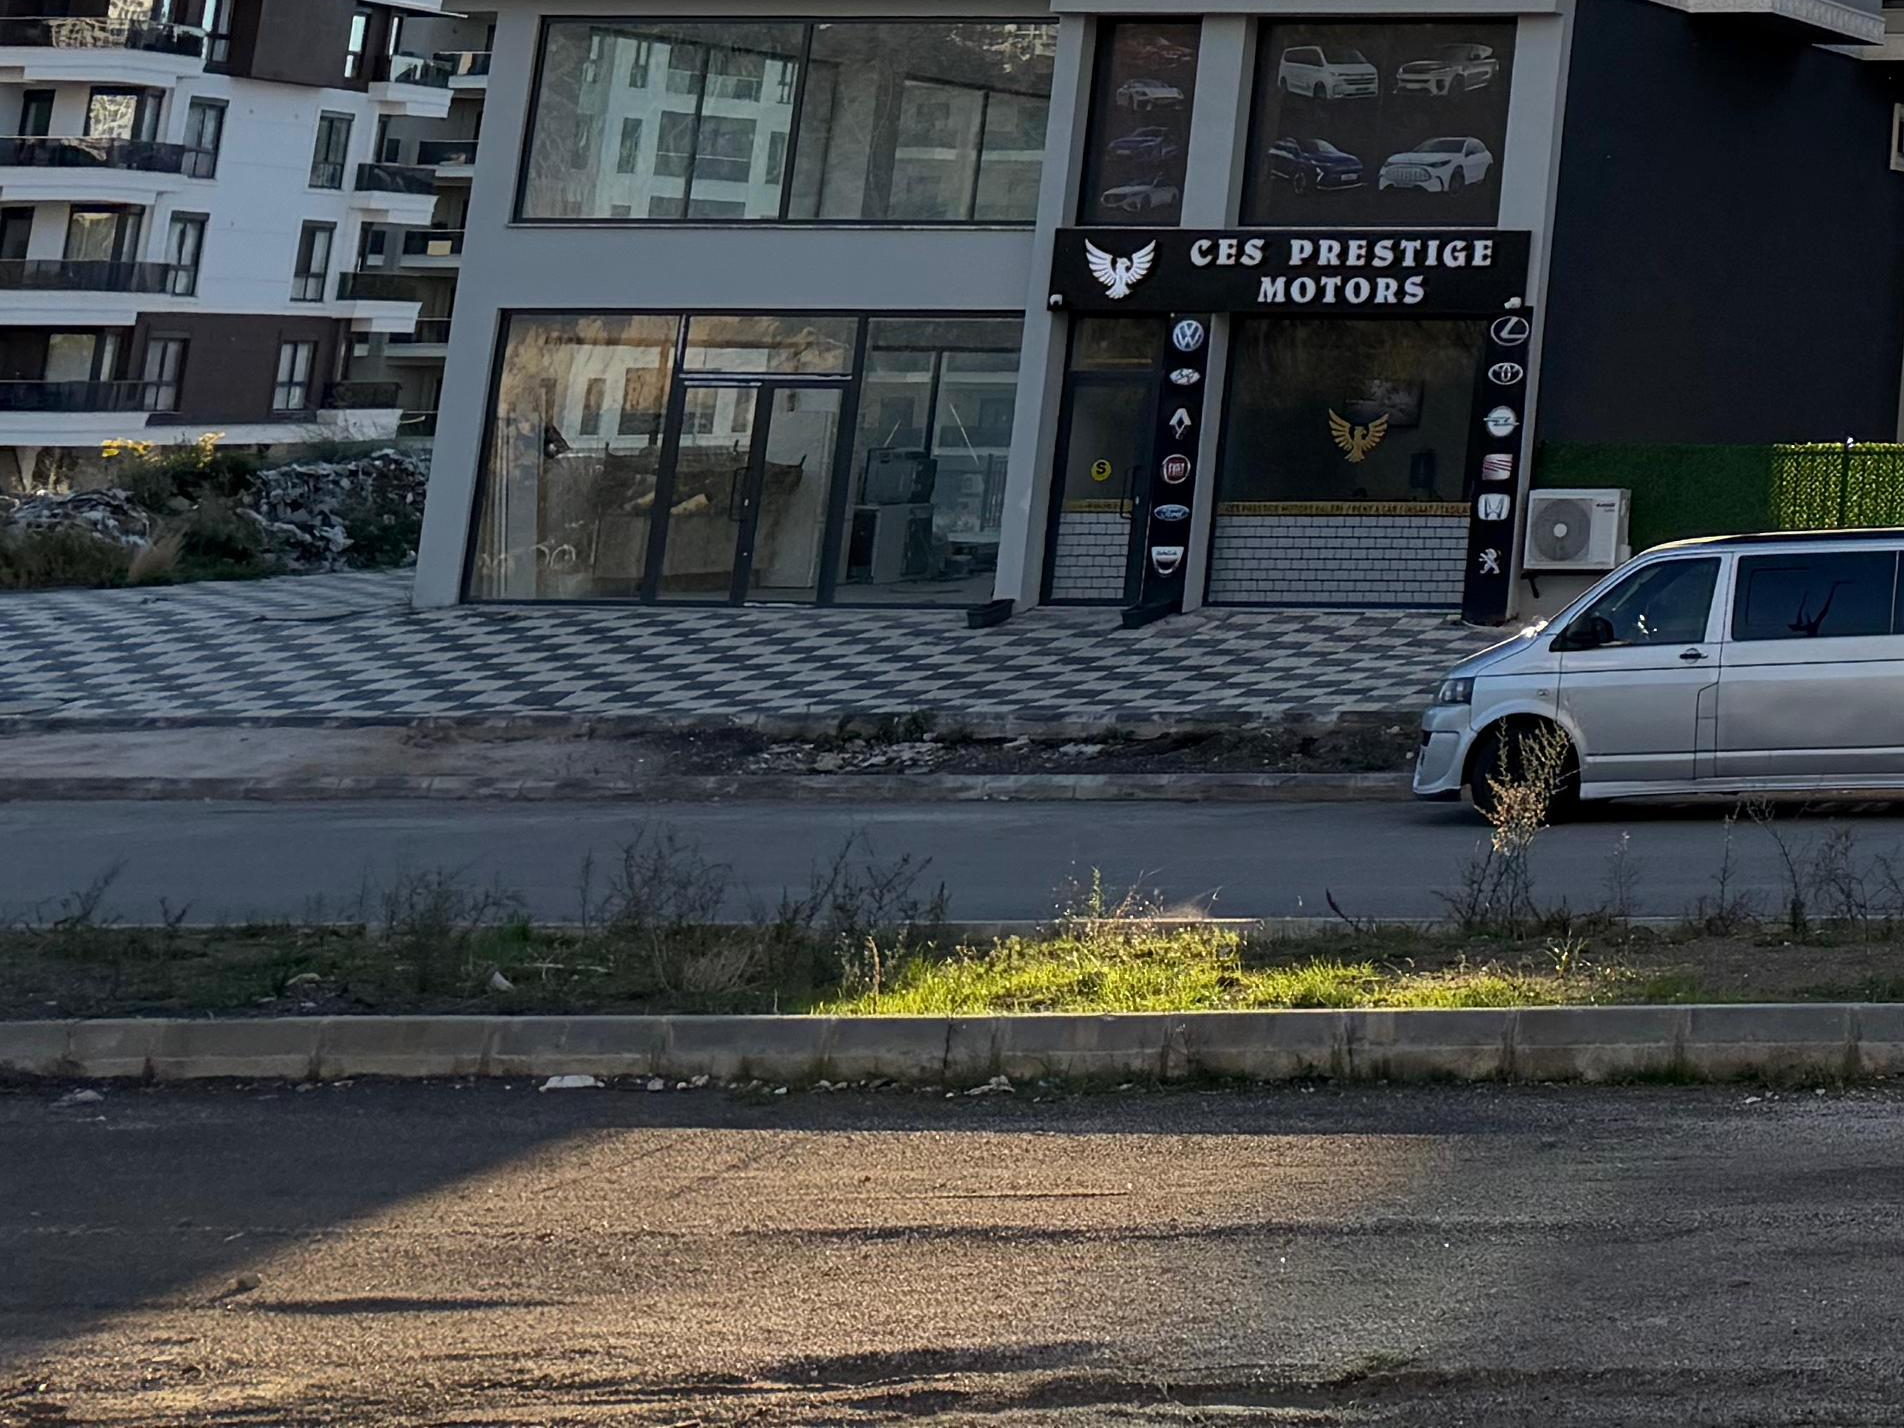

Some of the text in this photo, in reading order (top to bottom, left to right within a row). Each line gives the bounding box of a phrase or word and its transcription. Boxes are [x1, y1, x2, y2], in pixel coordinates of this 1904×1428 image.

[1190, 238, 1493, 267] CES PRESTIGE
[1257, 275, 1425, 304] MOTORS
[1096, 461, 1107, 474] S
